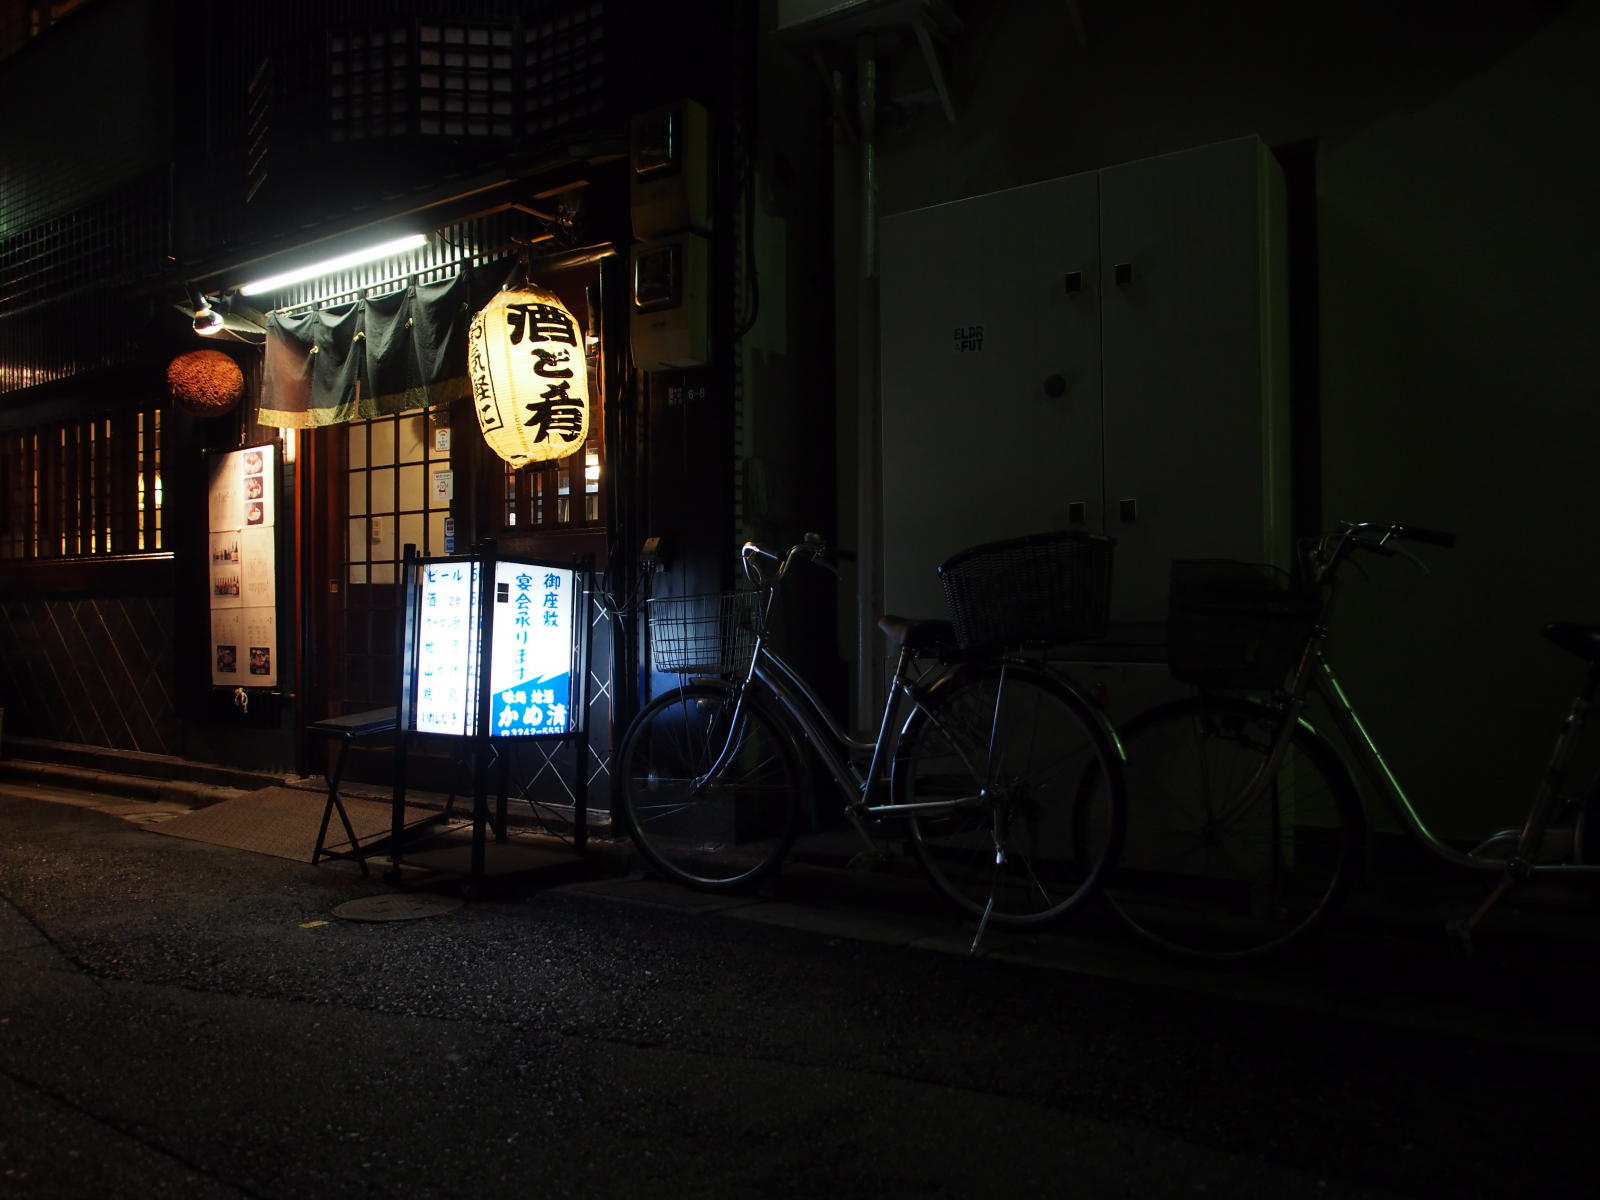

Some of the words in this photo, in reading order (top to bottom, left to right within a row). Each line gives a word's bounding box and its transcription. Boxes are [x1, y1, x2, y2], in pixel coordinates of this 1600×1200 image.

[427, 570, 463, 583] ビール
[543, 573, 561, 627] 御座敷
[515, 573, 533, 680] 宴会承ります
